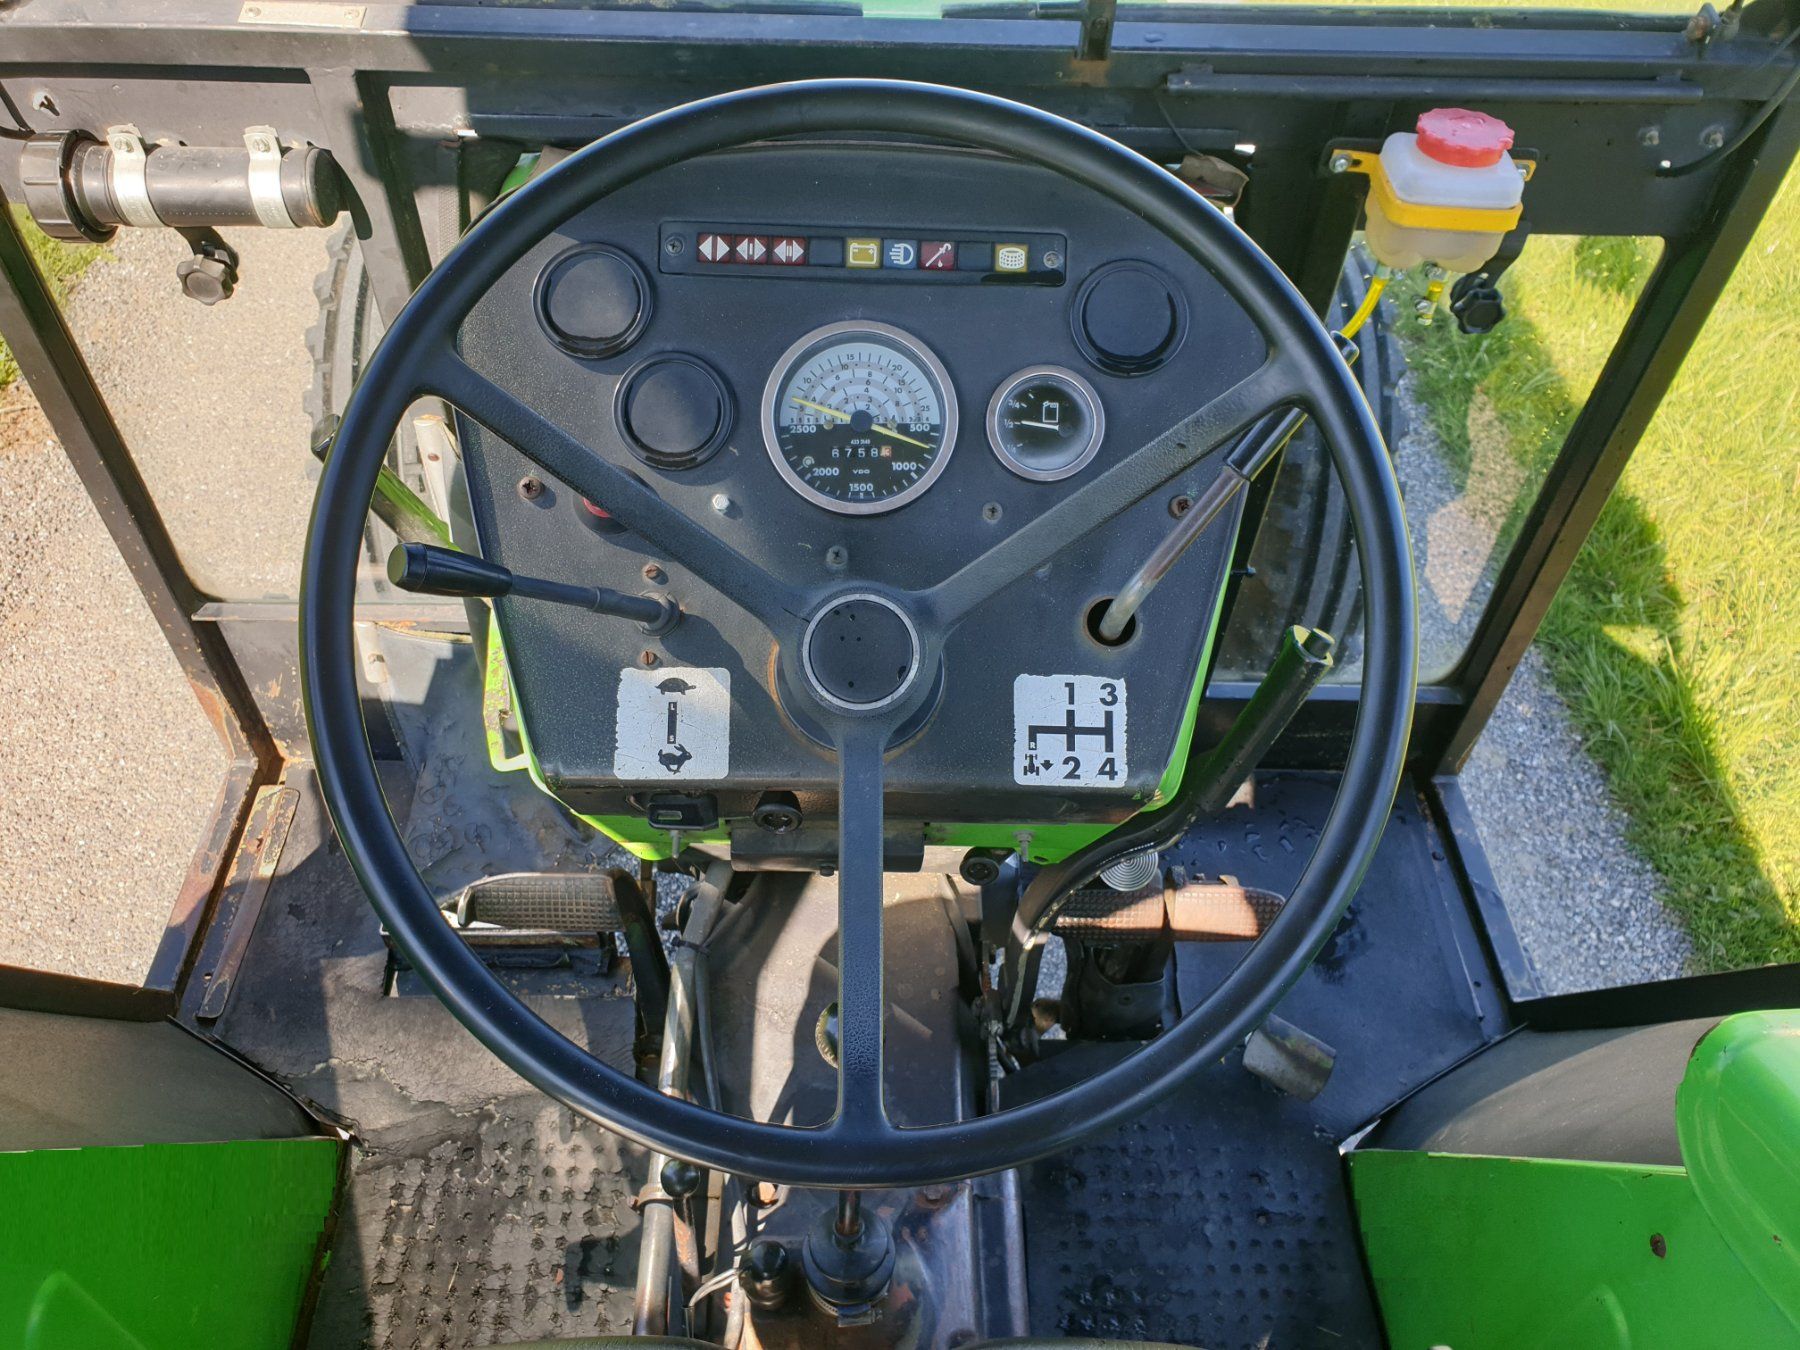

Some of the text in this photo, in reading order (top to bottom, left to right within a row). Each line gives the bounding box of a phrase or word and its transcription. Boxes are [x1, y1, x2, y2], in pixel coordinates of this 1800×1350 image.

[846, 353, 855, 361] 15
[841, 363, 849, 371] 10
[790, 425, 817, 433] 2500
[909, 423, 930, 432] 500
[891, 461, 917, 471] 1000
[812, 467, 840, 476] 2000
[849, 483, 874, 492] 1500
[1064, 682, 1075, 705] 1
[1099, 682, 1119, 706] 3
[670, 703, 675, 711] L
[1029, 741, 1036, 749] R
[1062, 755, 1081, 780] 2
[1096, 757, 1119, 781] 4
